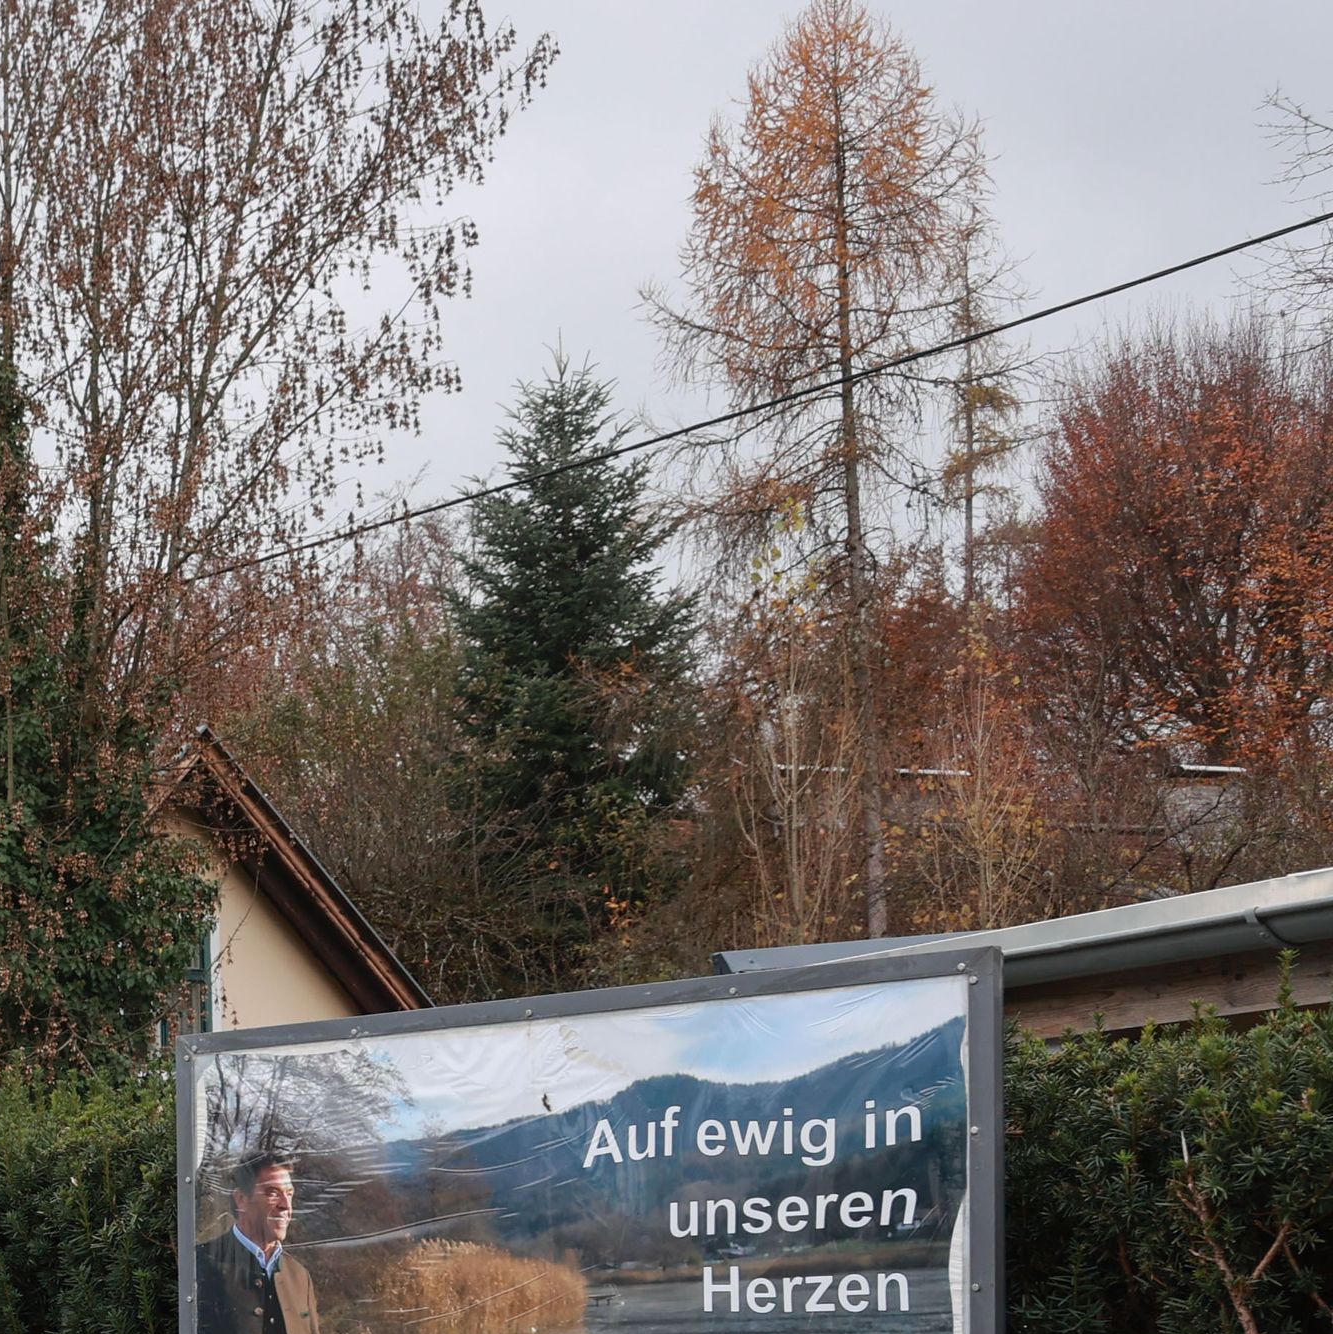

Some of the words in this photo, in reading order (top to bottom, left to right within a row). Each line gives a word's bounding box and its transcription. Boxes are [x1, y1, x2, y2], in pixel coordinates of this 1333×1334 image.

[582, 1105, 681, 1169] Auf
[696, 1107, 836, 1167] ewig
[864, 1099, 923, 1150] in
[669, 1186, 918, 1239] unseren
[702, 1265, 910, 1314] Herzen
